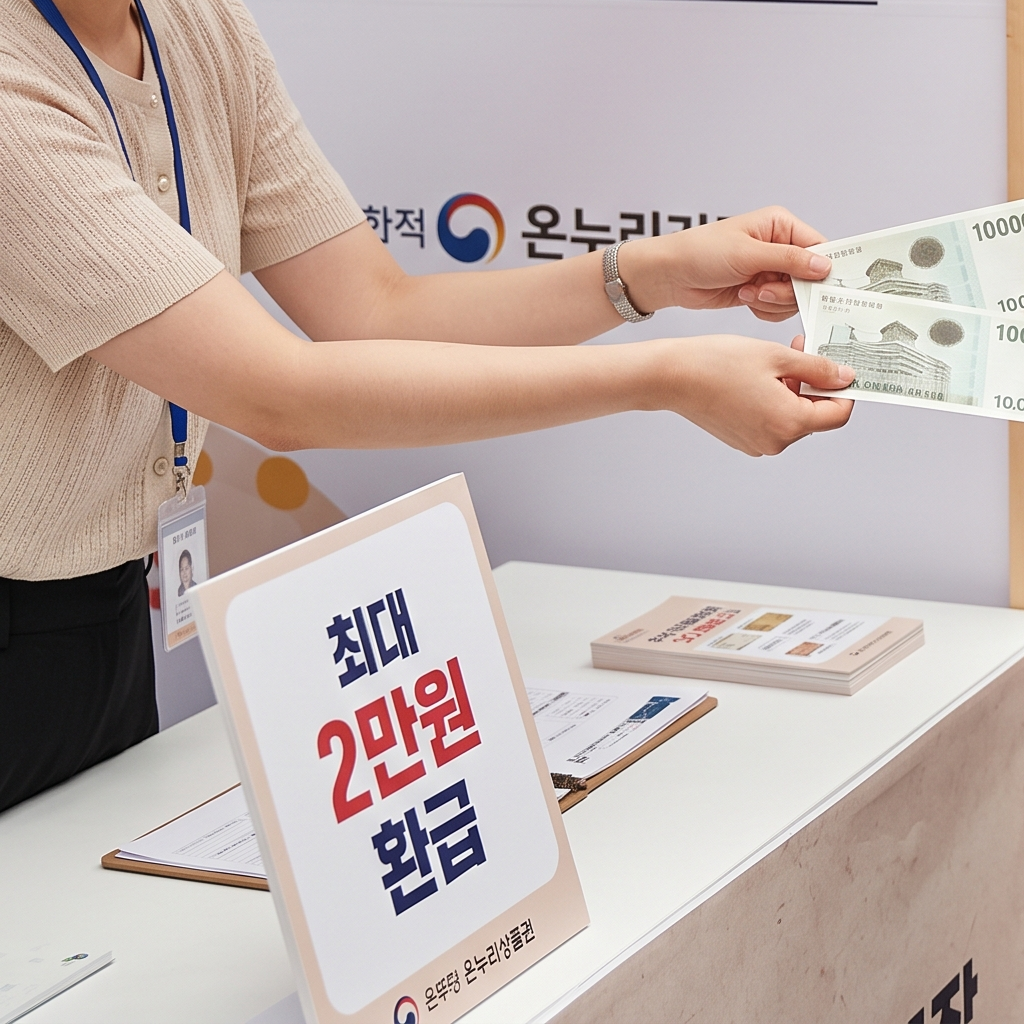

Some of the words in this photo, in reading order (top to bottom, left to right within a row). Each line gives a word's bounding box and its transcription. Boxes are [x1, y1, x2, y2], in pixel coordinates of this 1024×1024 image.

[326, 587, 420, 689] 최대
[317, 656, 482, 824] 2만원
[371, 778, 487, 917] 환급
